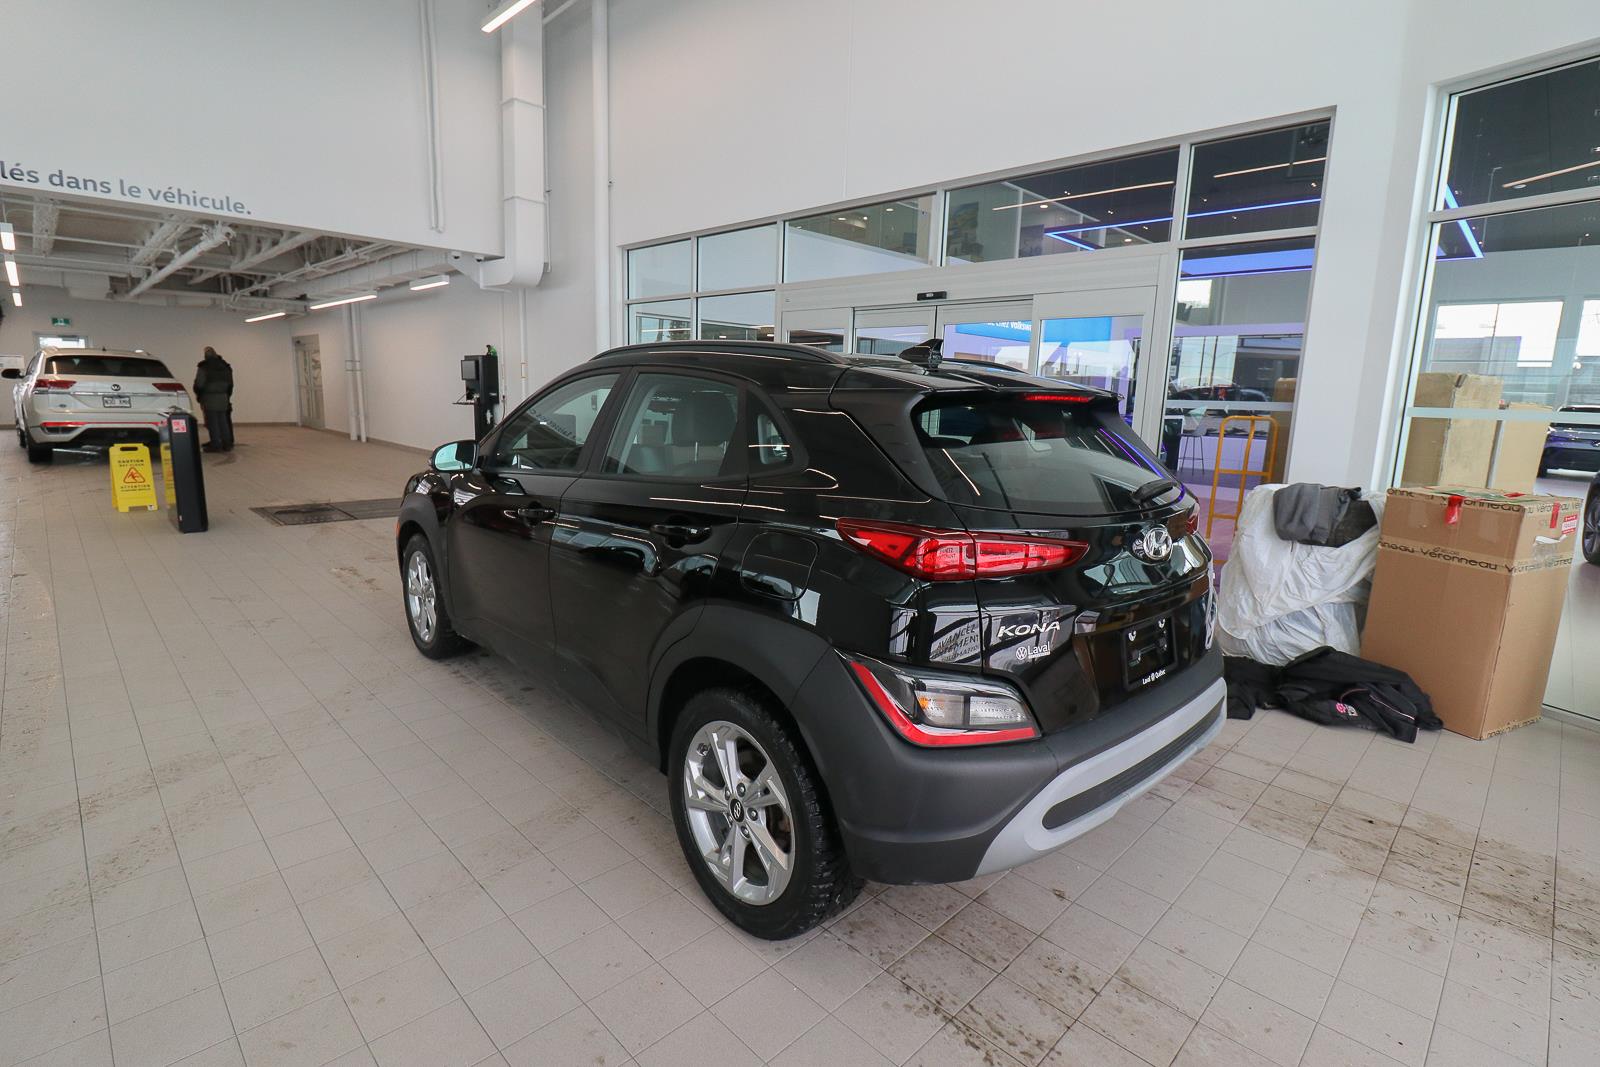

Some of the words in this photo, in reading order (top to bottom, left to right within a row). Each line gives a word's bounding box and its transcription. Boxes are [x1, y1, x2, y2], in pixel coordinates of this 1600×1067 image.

[48, 169, 112, 194] dans
[119, 179, 141, 198] le
[148, 186, 252, 215] véhicule.
[997, 621, 1060, 637] KONA
[1027, 641, 1050, 655] Laval
